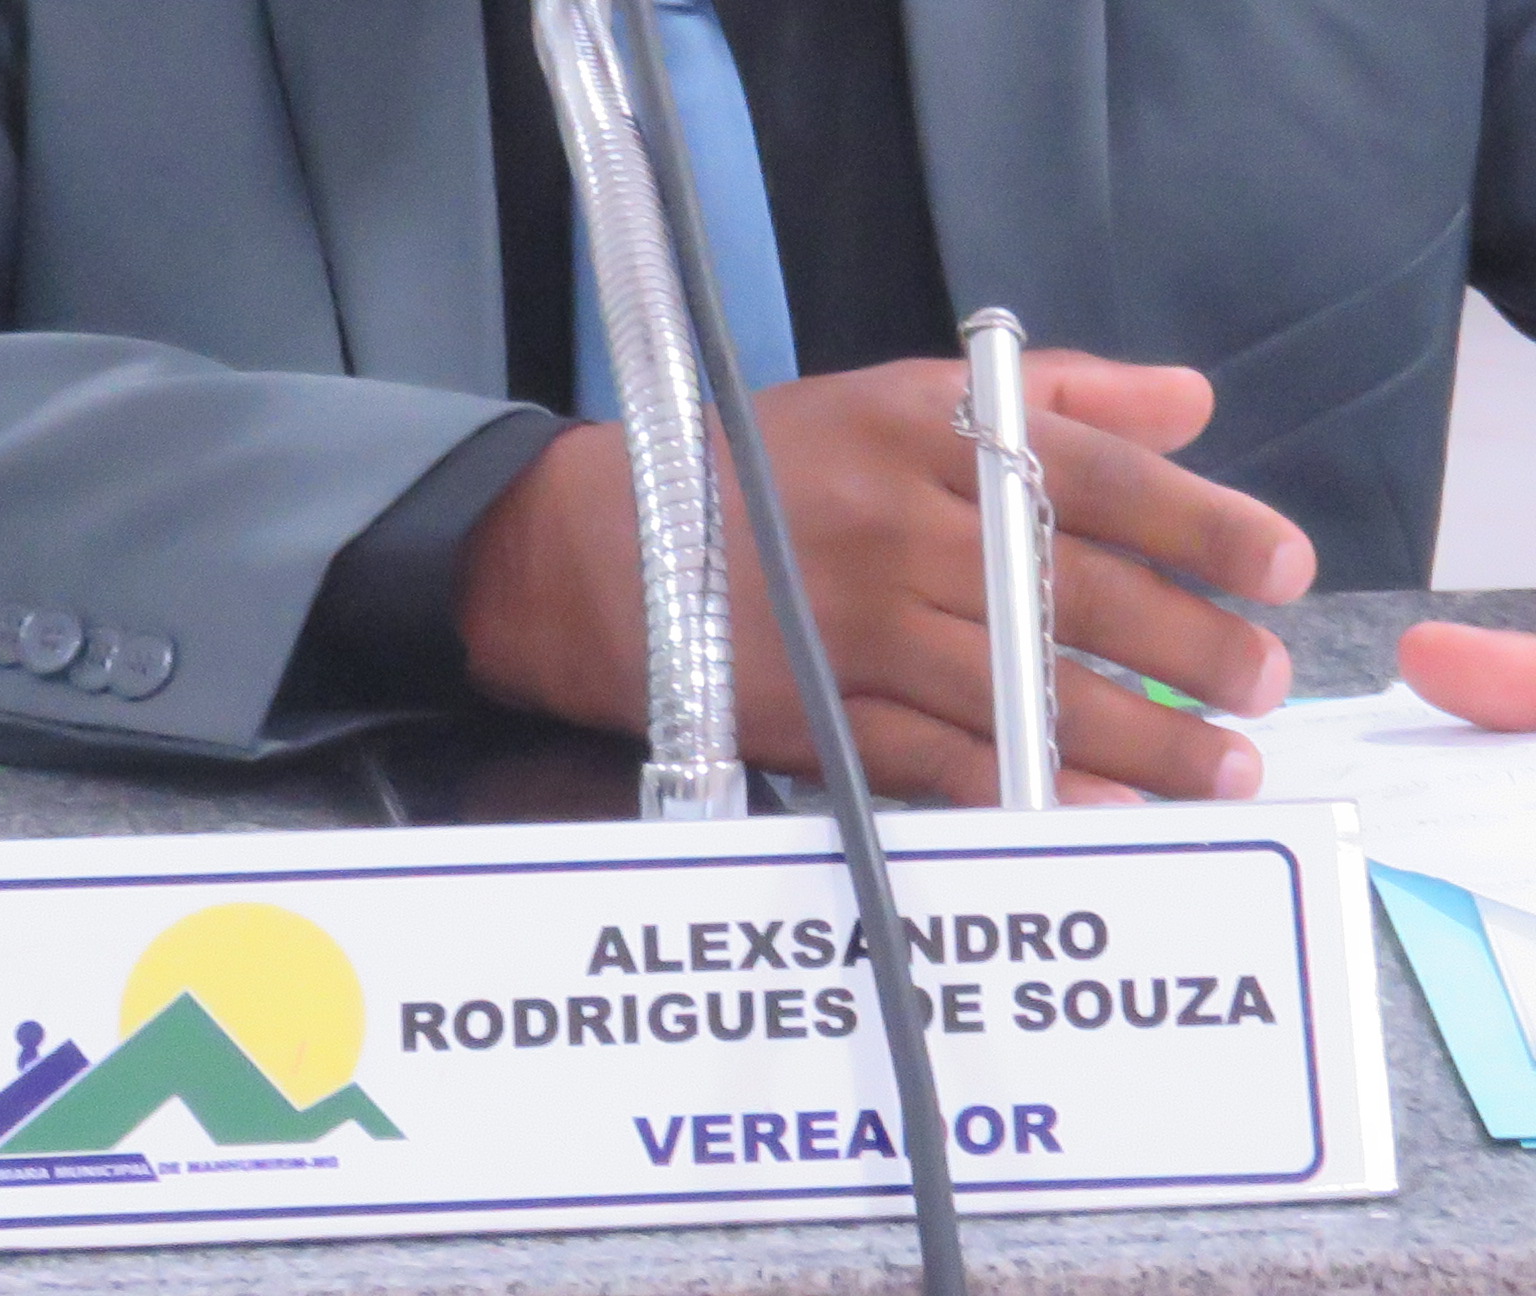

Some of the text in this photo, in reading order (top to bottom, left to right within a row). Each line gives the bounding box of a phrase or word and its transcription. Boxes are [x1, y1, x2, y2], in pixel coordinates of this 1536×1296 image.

[399, 987, 858, 1053] RODRIGUES
[1012, 975, 1277, 1032] SOUZA
[631, 1103, 1064, 1167] VEREAOR
